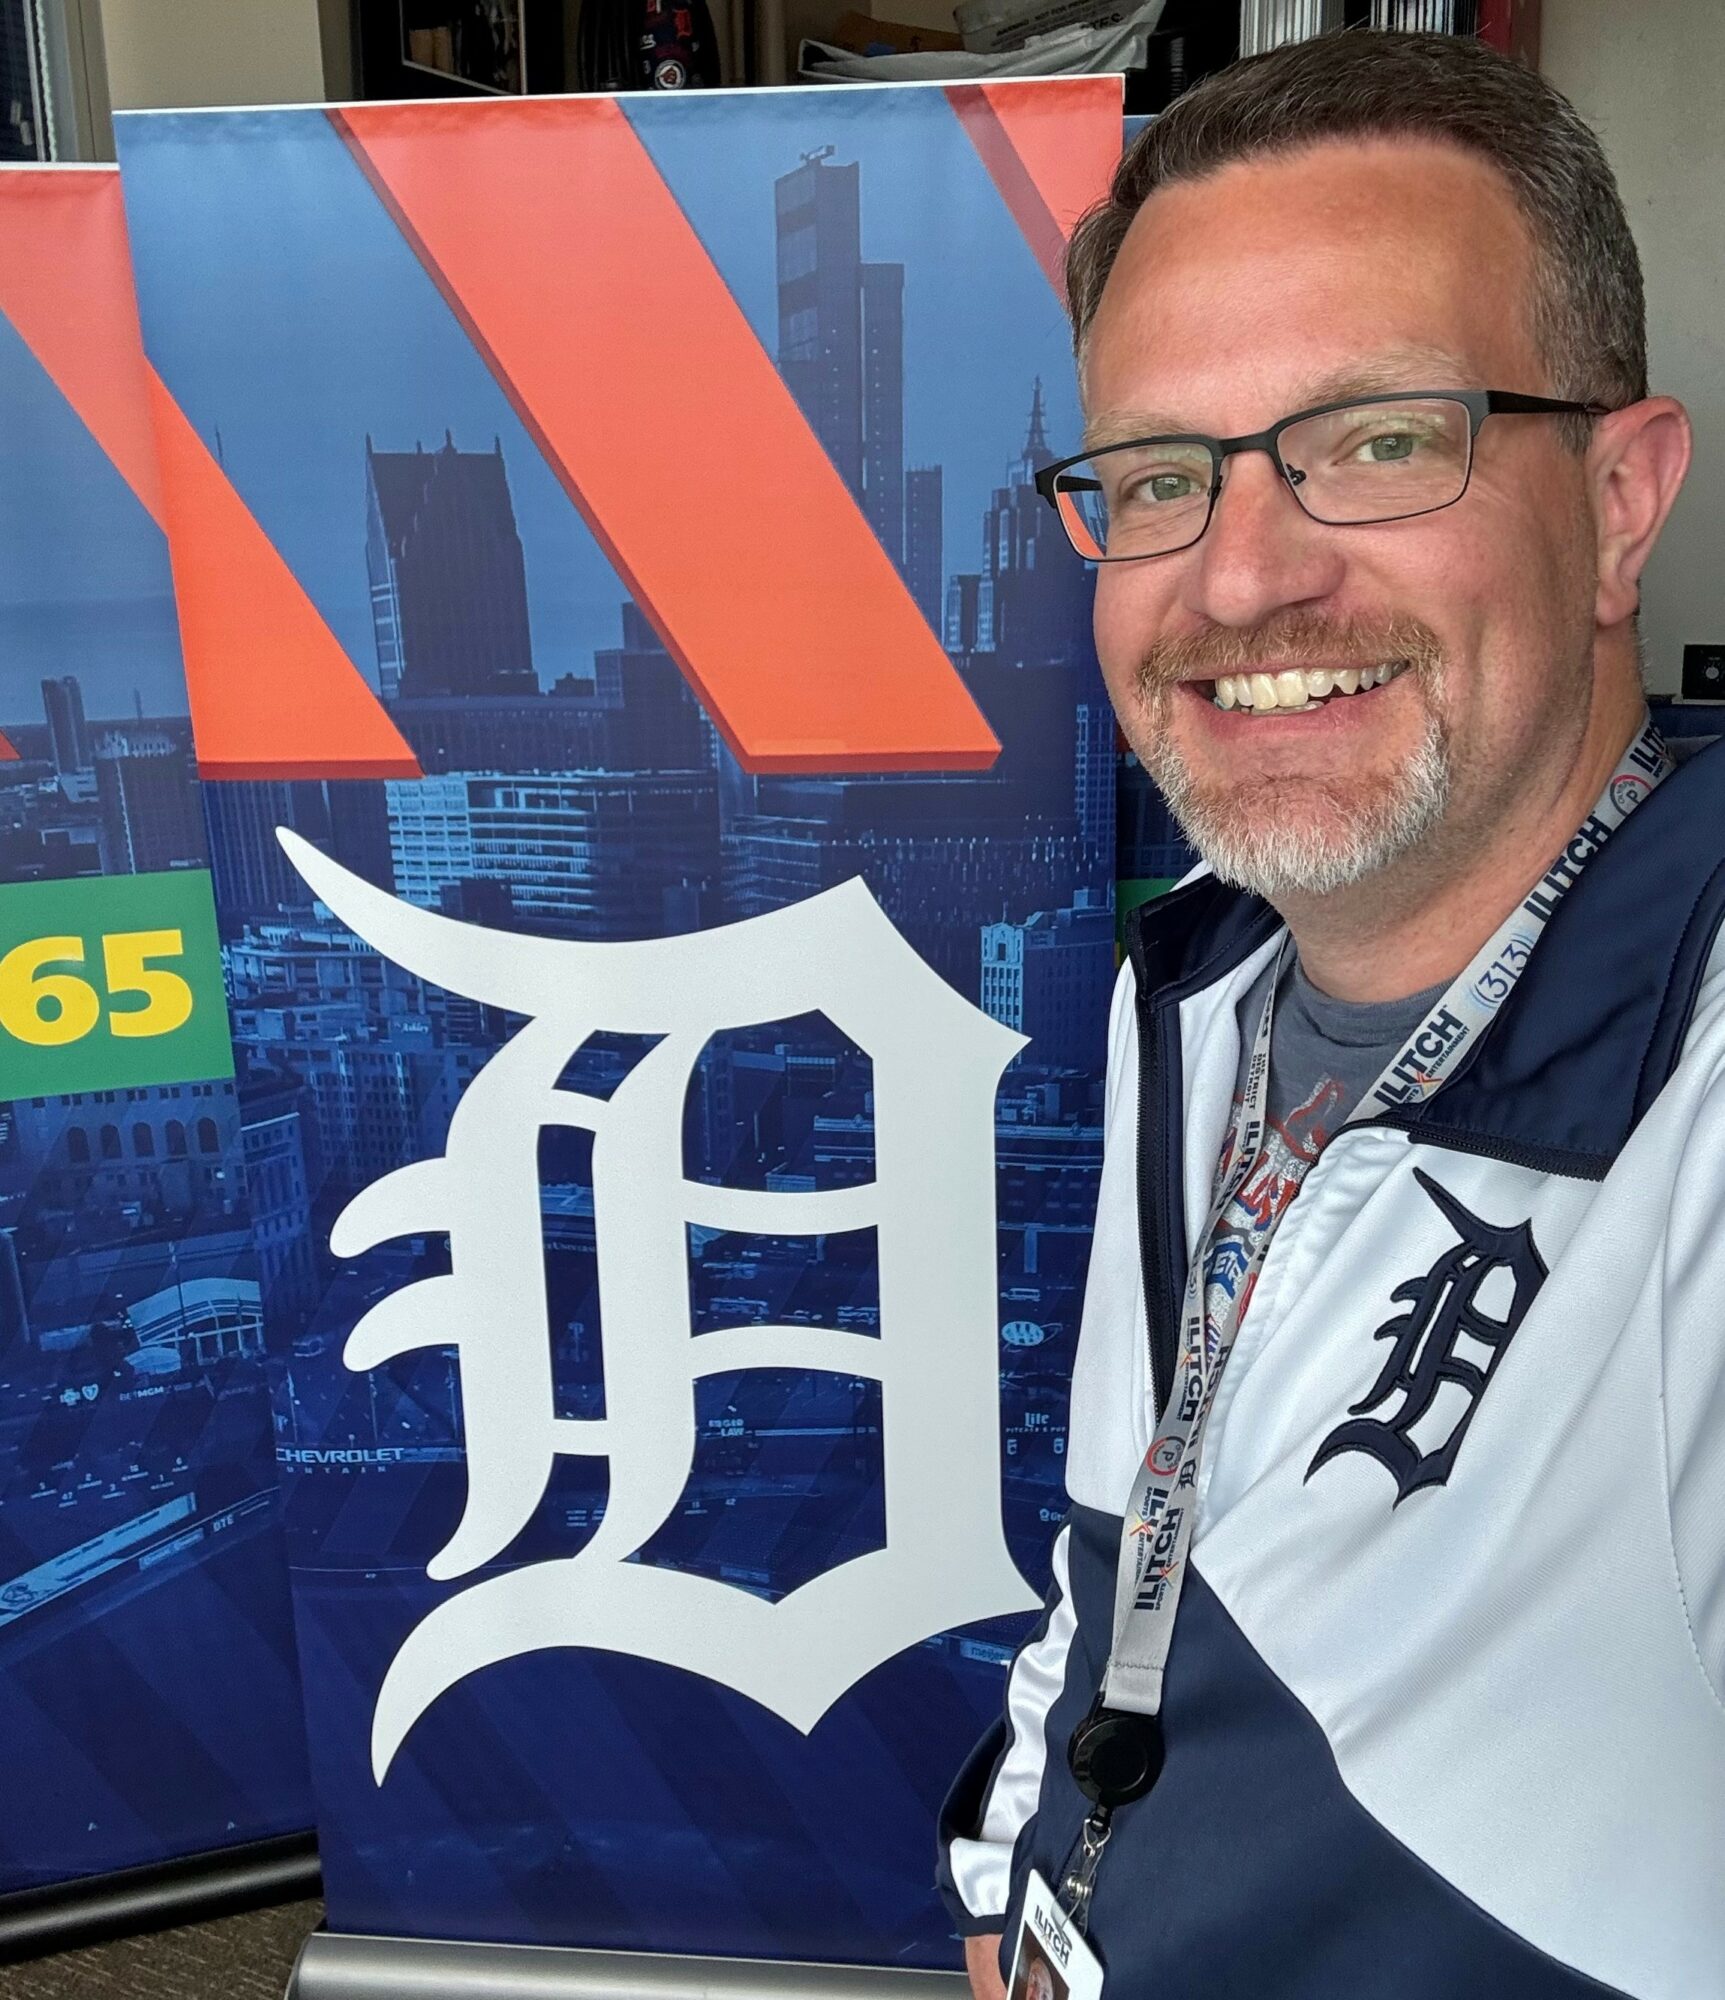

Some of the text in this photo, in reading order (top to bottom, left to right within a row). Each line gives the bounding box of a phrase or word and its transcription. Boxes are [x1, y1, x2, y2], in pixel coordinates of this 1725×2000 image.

[1523, 814, 1613, 922] ILITCH
[0, 929, 193, 1046] 65
[1248, 1053, 1263, 1109] DISTRICT
[1373, 1007, 1464, 1109] ILITCH
[1425, 1025, 1471, 1079] ENTERTAINMENT
[1181, 1316, 1203, 1422] ILITCH
[720, 1427, 745, 1437] LAW
[1024, 1412, 1050, 1428] Lite
[276, 1447, 404, 1463] CHEVROLET
[1142, 1486, 1153, 1517] SPORTS
[1134, 1507, 1181, 1612] ILITCH
[1155, 1507, 1185, 1611] SPORTS ENTERTAINMENT
[1034, 1904, 1071, 1967] ILITCH
